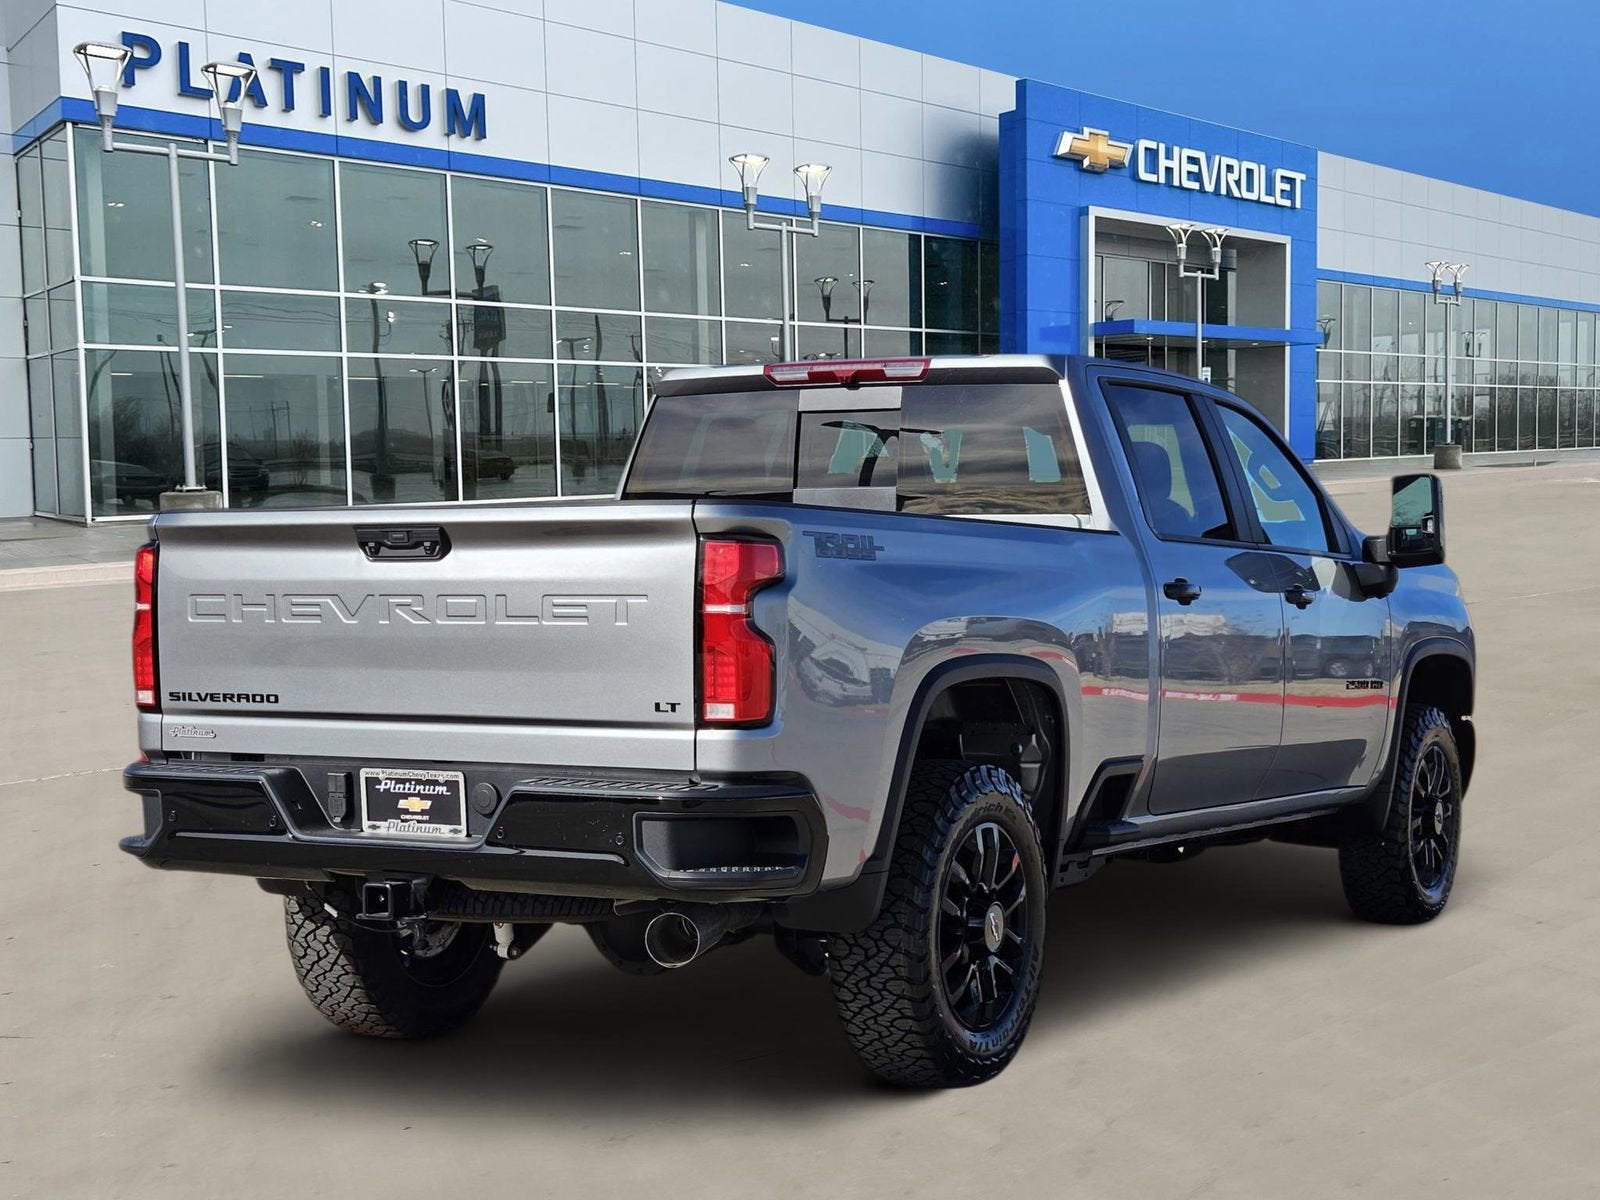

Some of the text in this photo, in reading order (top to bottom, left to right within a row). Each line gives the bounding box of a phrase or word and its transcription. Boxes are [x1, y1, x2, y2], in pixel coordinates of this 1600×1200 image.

[120, 31, 487, 140] PLATINUM
[1135, 139, 1306, 209] CHEVROLET
[186, 593, 649, 626] CHEVROLET
[169, 691, 279, 704] SILVERADO
[654, 701, 681, 714] LT
[375, 780, 452, 795] Platinum
[385, 820, 444, 834] Platinum
